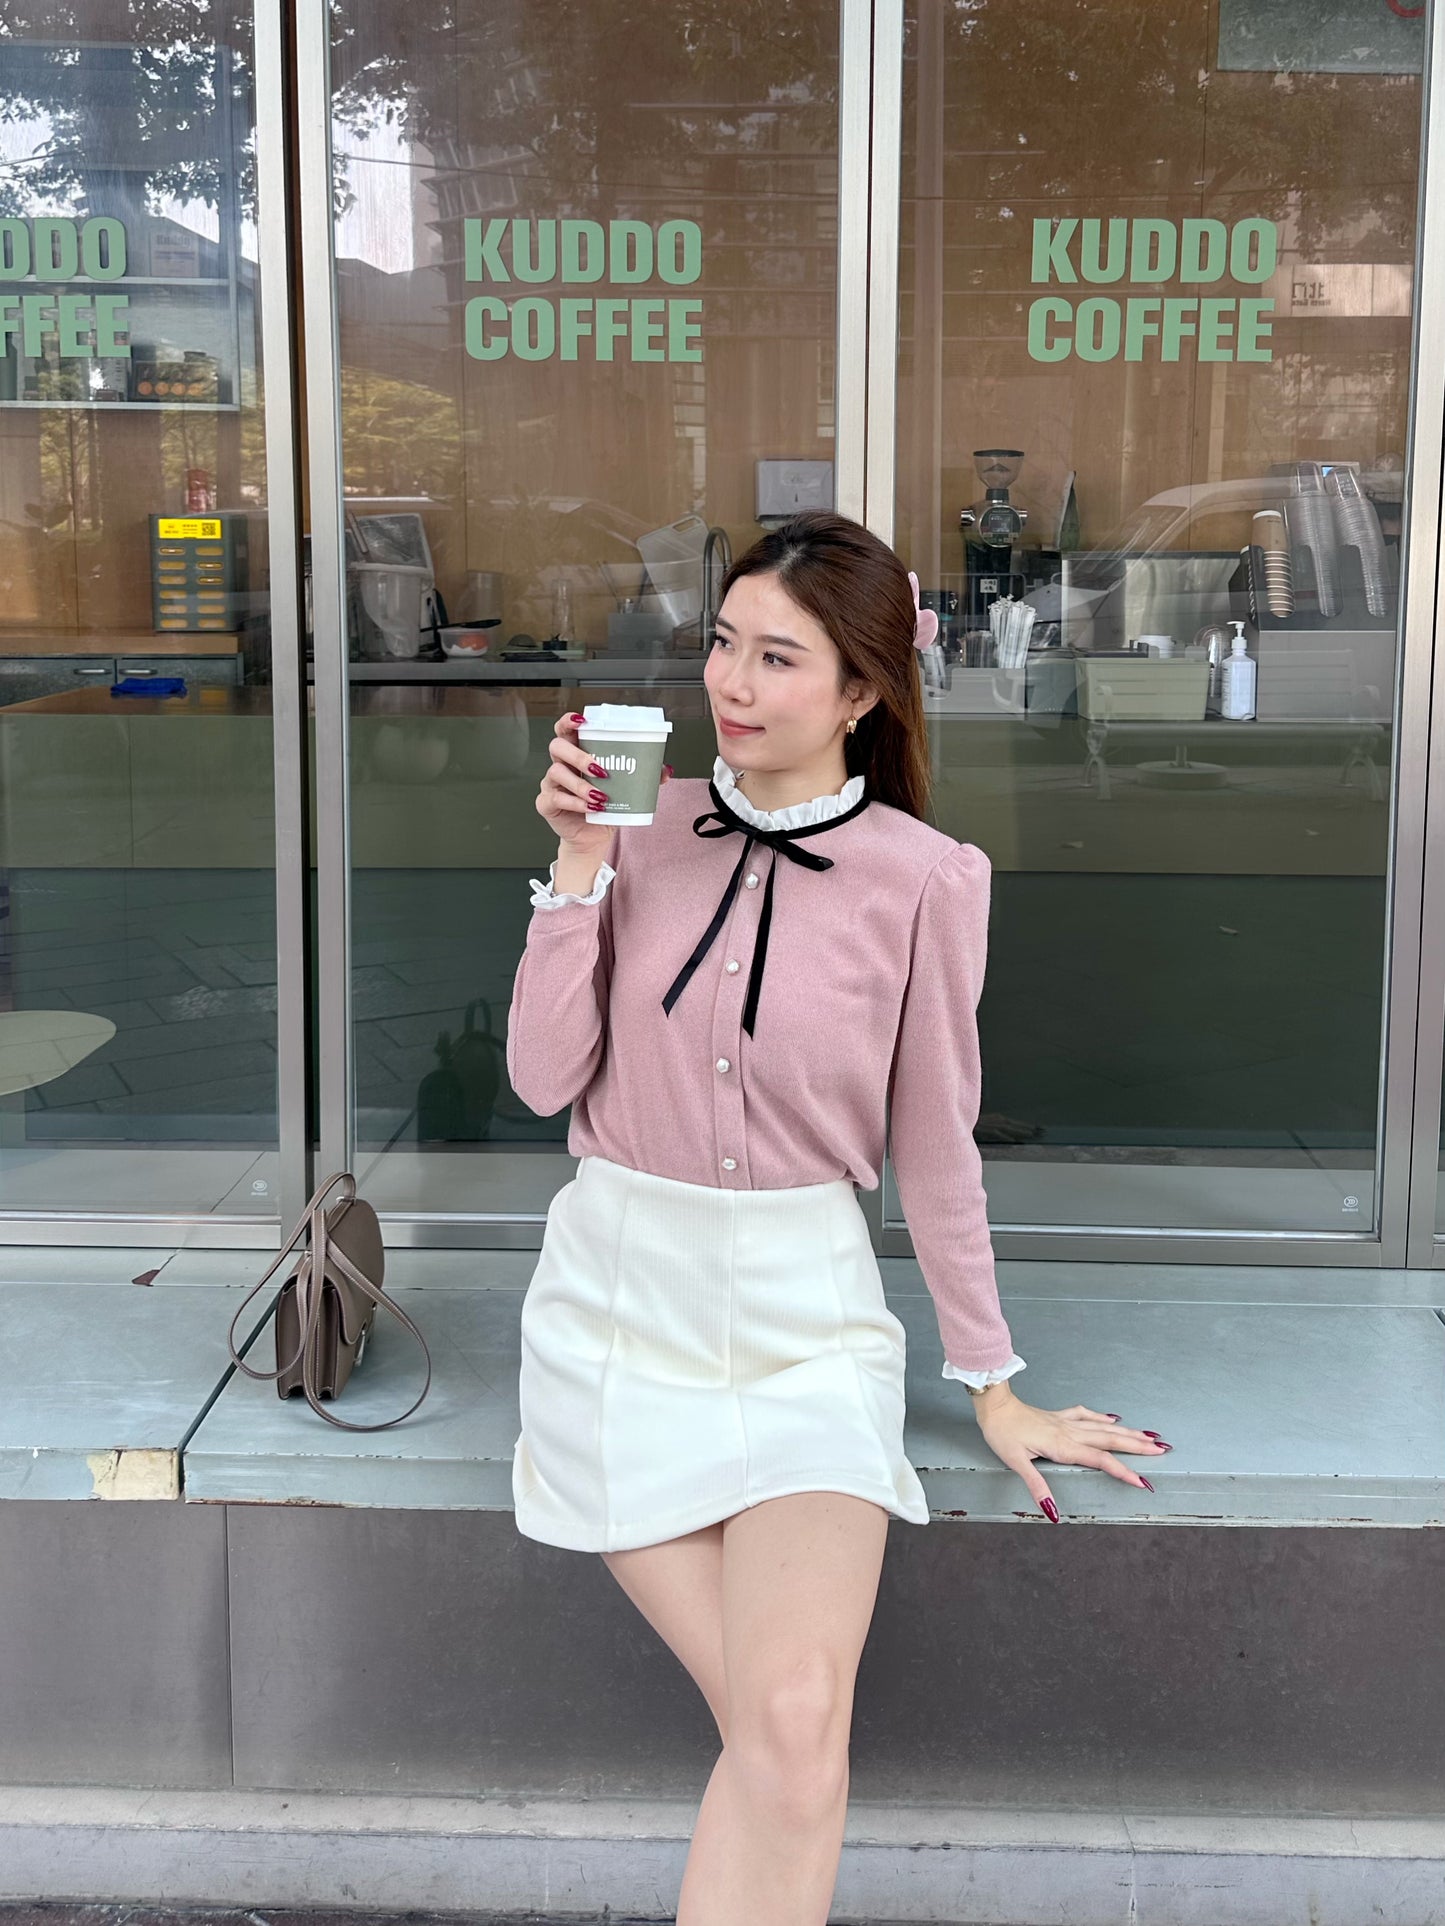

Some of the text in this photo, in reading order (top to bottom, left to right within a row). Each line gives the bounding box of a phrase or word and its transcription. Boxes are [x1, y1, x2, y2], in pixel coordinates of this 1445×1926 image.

[464, 218, 703, 285] KUDDO
[1030, 217, 1278, 284] KUDDO
[465, 296, 703, 362] COFFEE
[1027, 297, 1274, 362] COFFEE
[590, 753, 637, 775] uddo
